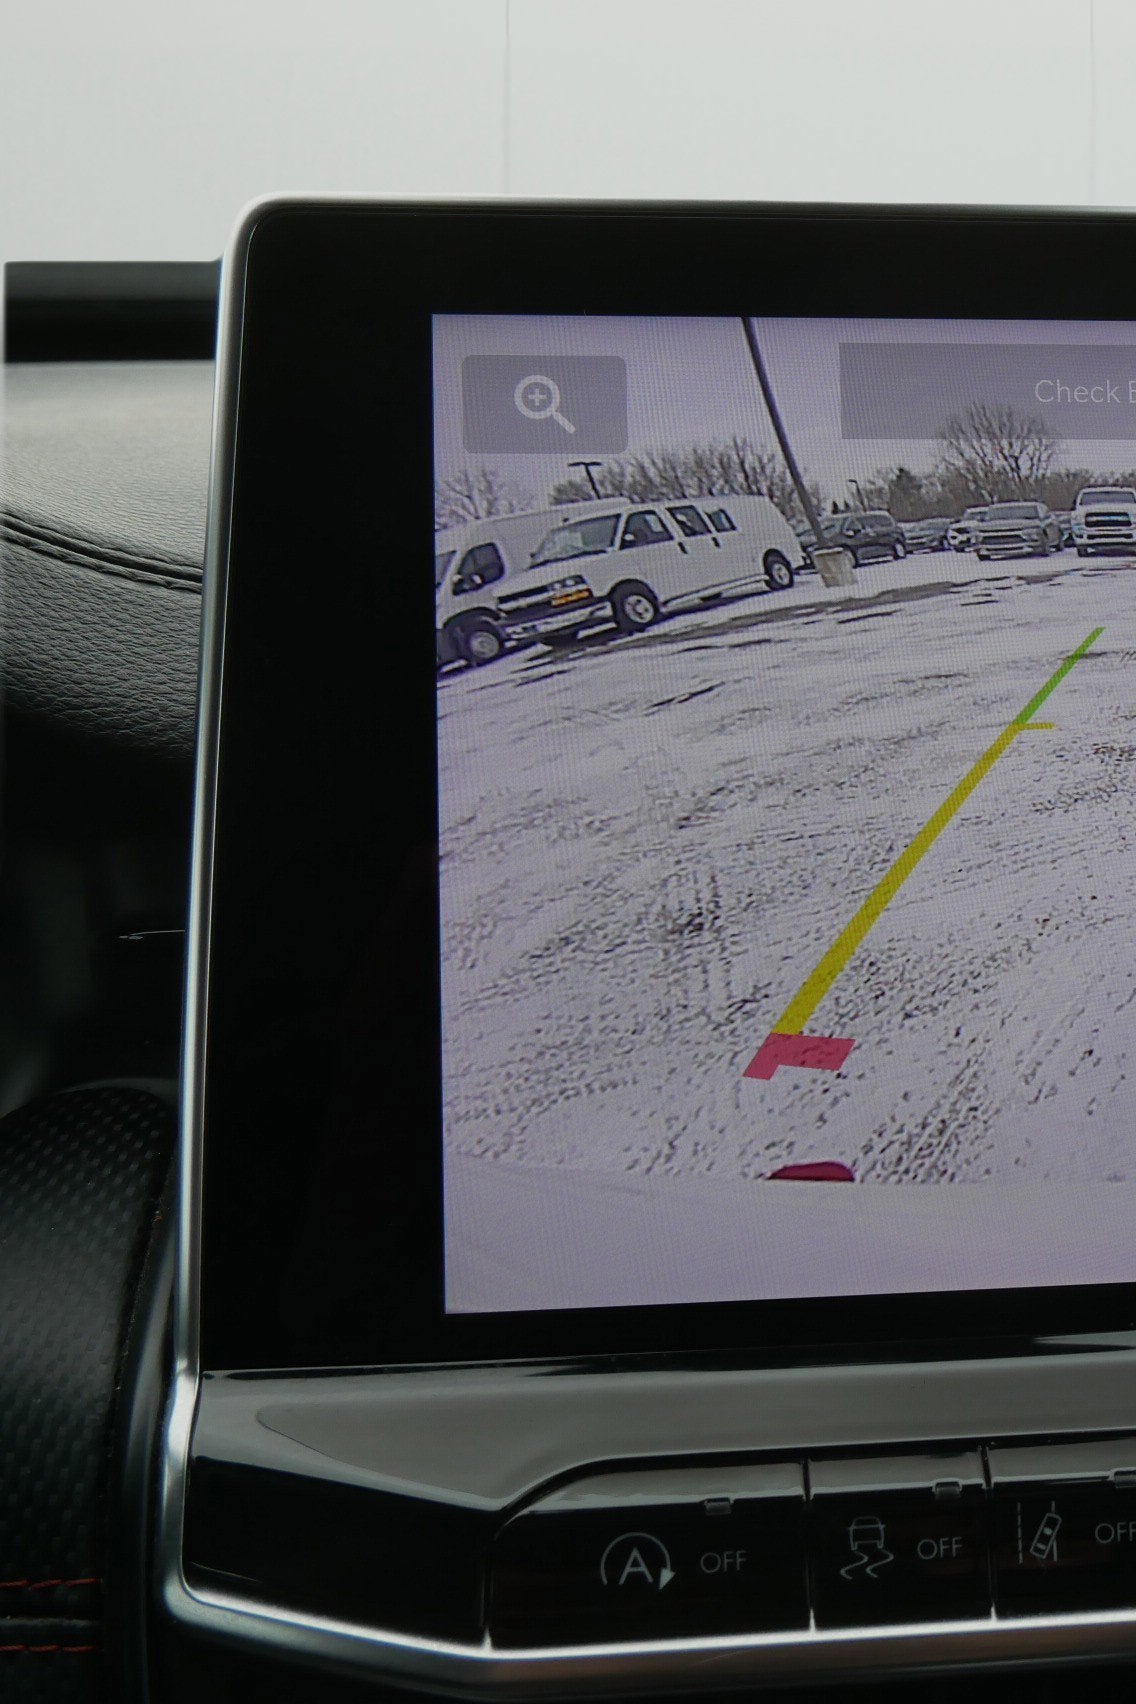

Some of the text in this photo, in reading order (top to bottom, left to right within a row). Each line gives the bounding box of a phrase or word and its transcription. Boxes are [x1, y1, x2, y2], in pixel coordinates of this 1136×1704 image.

[1034, 378, 1121, 404] Check
[916, 1536, 963, 1560] OFF
[700, 1550, 747, 1574] OFF
